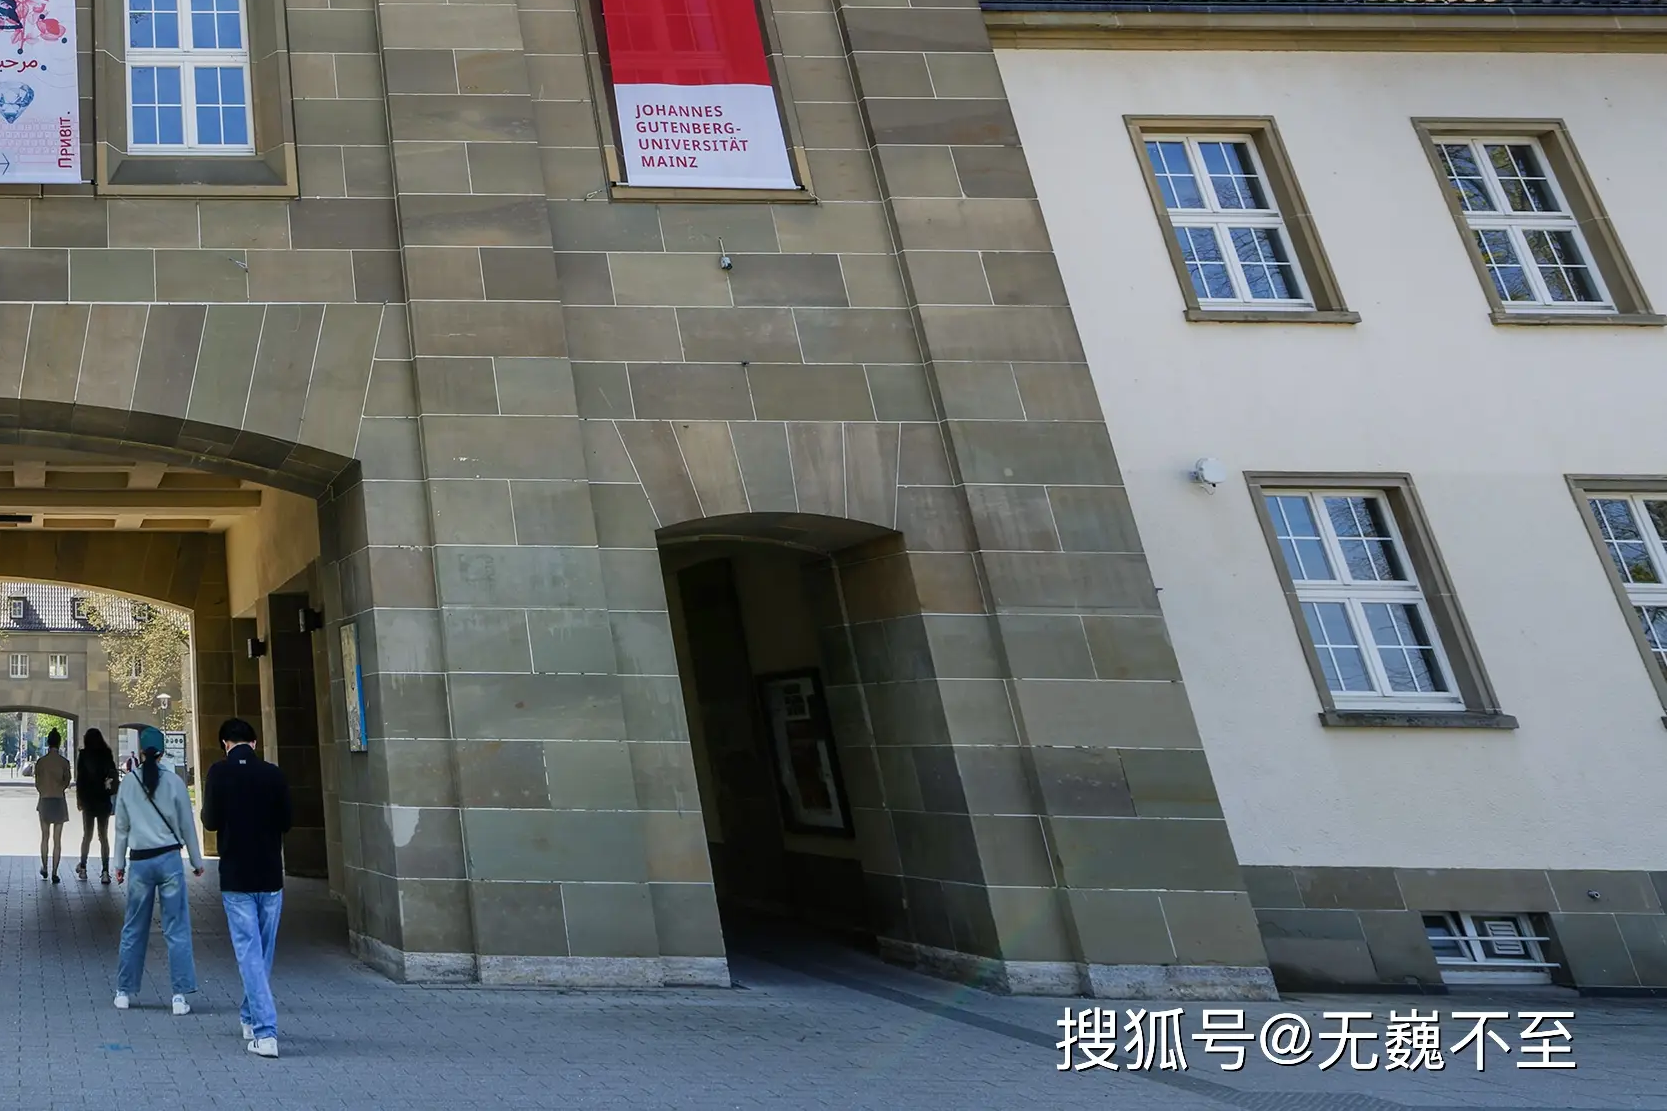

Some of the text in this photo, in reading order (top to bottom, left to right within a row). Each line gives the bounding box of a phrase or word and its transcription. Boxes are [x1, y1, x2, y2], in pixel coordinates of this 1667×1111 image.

[635, 104, 723, 119] JOHANNES
[636, 121, 742, 135] GUTENBERG-
[638, 137, 749, 151] UNIVERSITÄT
[641, 155, 698, 169] MAINZ
